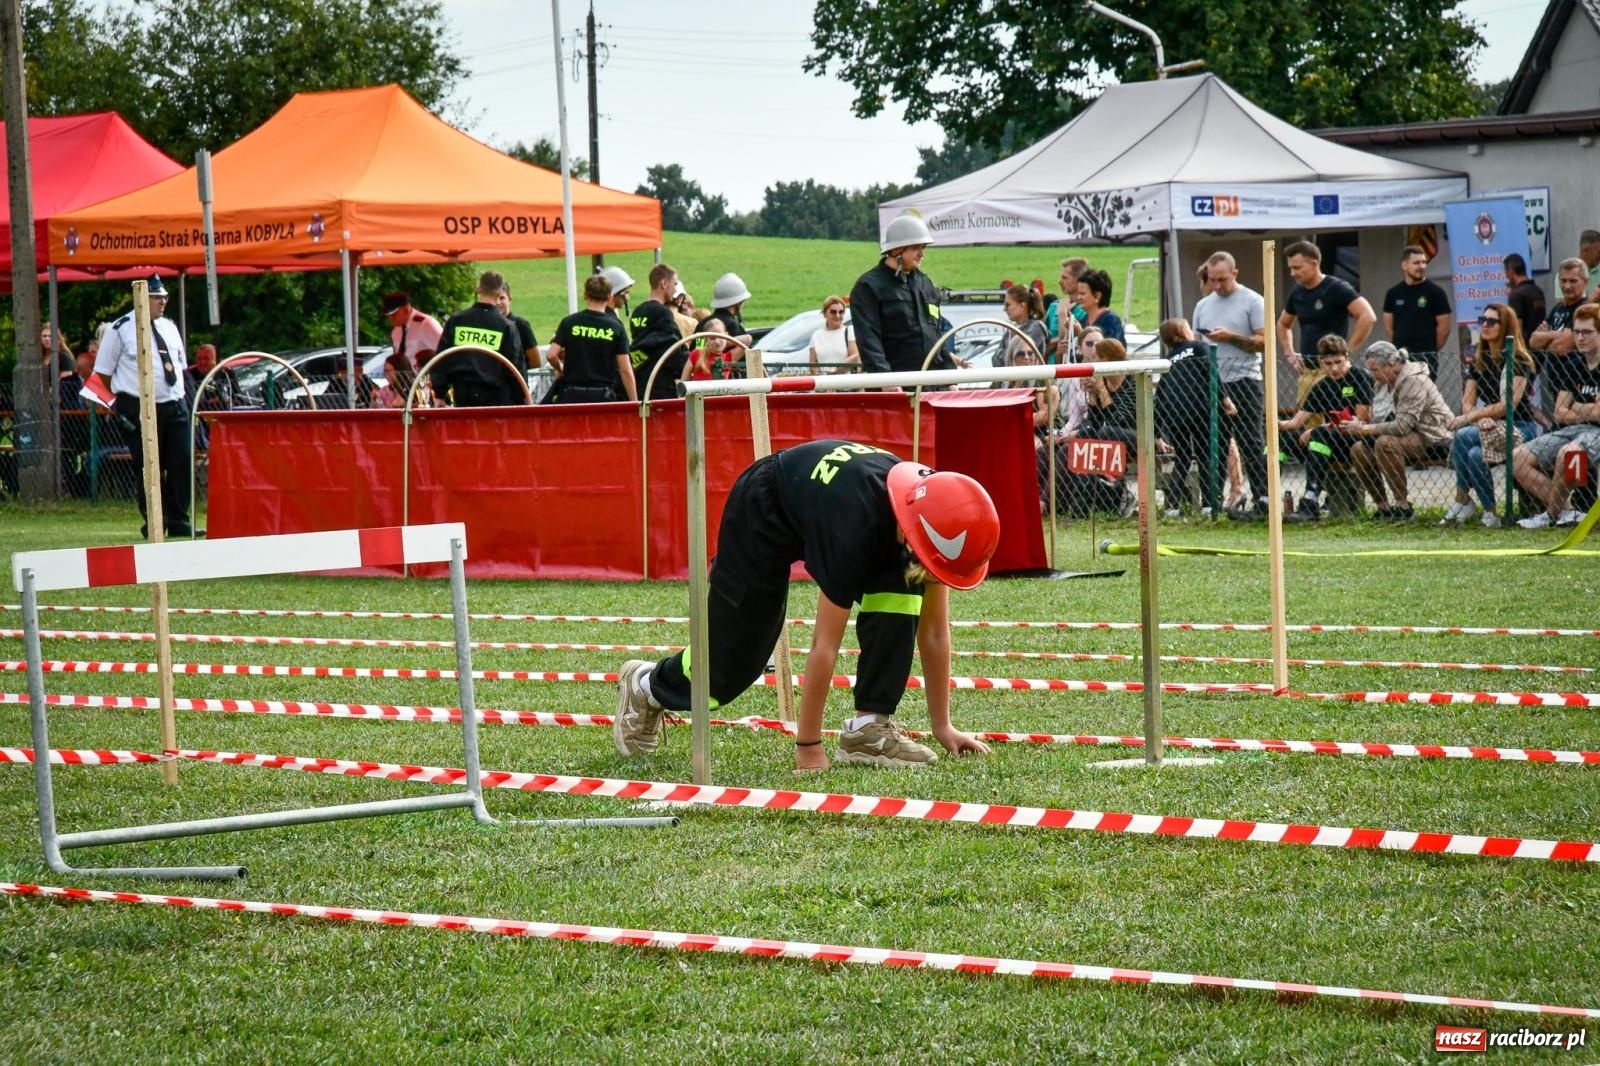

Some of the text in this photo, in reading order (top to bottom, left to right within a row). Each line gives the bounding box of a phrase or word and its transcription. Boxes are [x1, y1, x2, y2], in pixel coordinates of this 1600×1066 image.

[444, 216, 566, 235] OSP KOBYLA
[929, 215, 966, 233] Gmina
[90, 222, 295, 250] Ochotnicza Straż Poarna KOBYLA
[1457, 254, 1506, 266] Ochotnic
[1468, 287, 1508, 298] Rzucho
[571, 324, 615, 341] STRAŻ
[1072, 441, 1123, 473] META
[1568, 453, 1581, 481] 1
